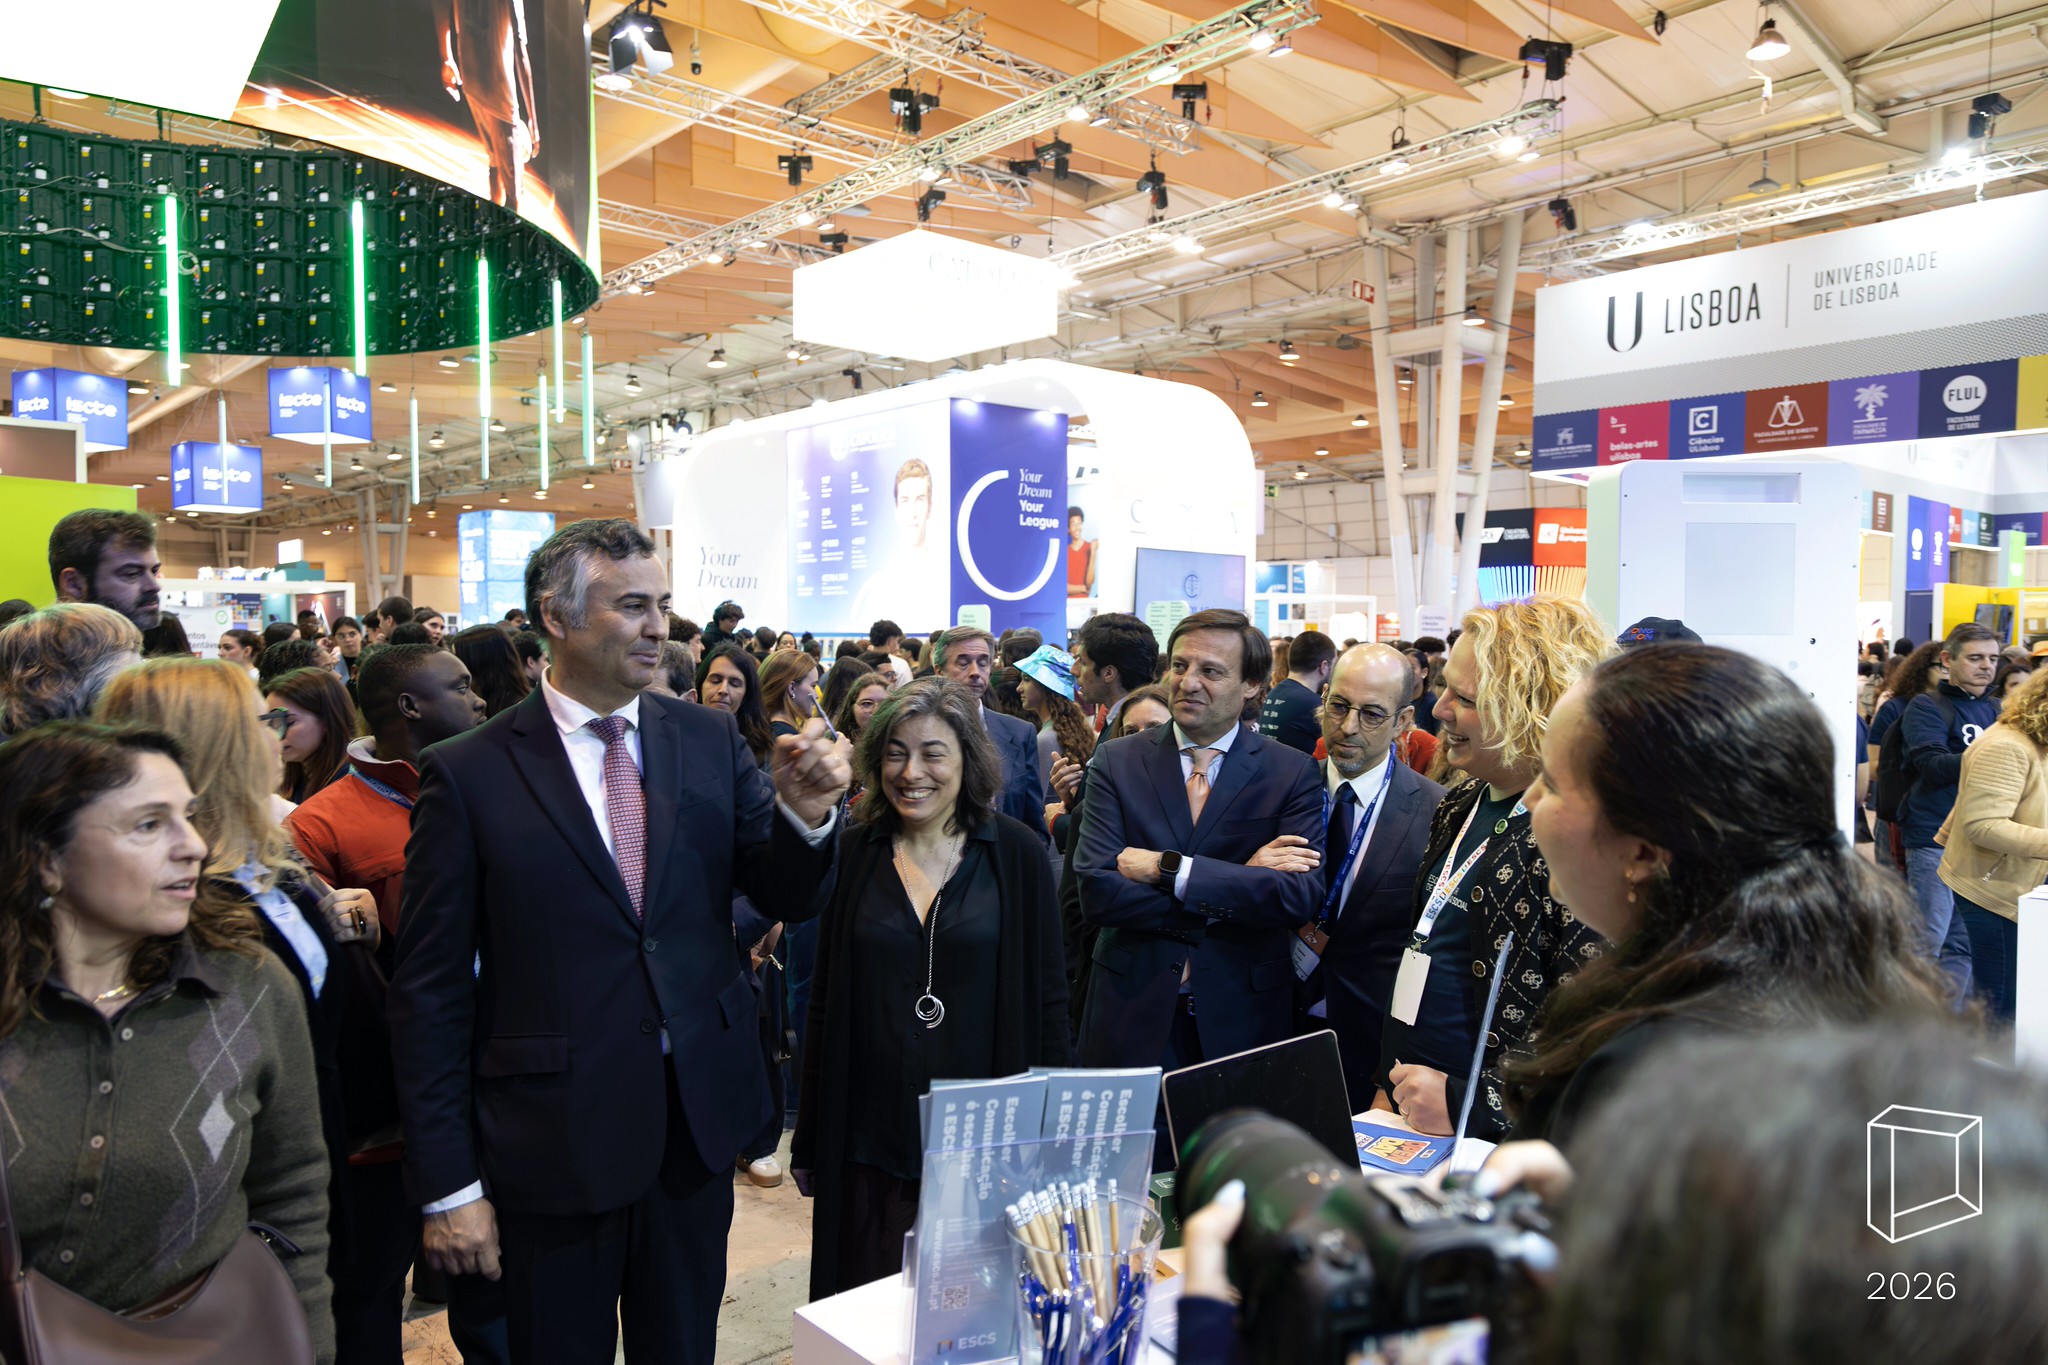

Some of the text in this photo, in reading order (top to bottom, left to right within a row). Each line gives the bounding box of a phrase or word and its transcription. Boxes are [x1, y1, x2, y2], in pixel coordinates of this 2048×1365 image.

[1815, 250, 1938, 289] UNIVERSIDADE
[1814, 281, 1900, 311] DE LISBOA
[1607, 282, 1760, 352] U LISBOA
[1948, 386, 1981, 402] FLUL
[1609, 440, 1659, 452] belas-artes
[1019, 468, 1043, 483] Your
[1017, 482, 1053, 499] Dream
[1019, 499, 1044, 513] Your
[1019, 513, 1059, 531] League
[701, 546, 741, 567] Your
[697, 569, 758, 589] Dream
[1445, 871, 1463, 895] ESCS
[1425, 898, 1443, 921] ESCS
[1062, 1090, 1072, 1101] a
[945, 1103, 956, 1113] a
[1001, 1096, 1020, 1163] Escolher
[1072, 1090, 1095, 1168] é escolher
[1111, 1089, 1133, 1154] Escolher
[961, 1100, 980, 1179] é escolher
[978, 1099, 999, 1201] Comunicação
[957, 1332, 997, 1350] ESCS
